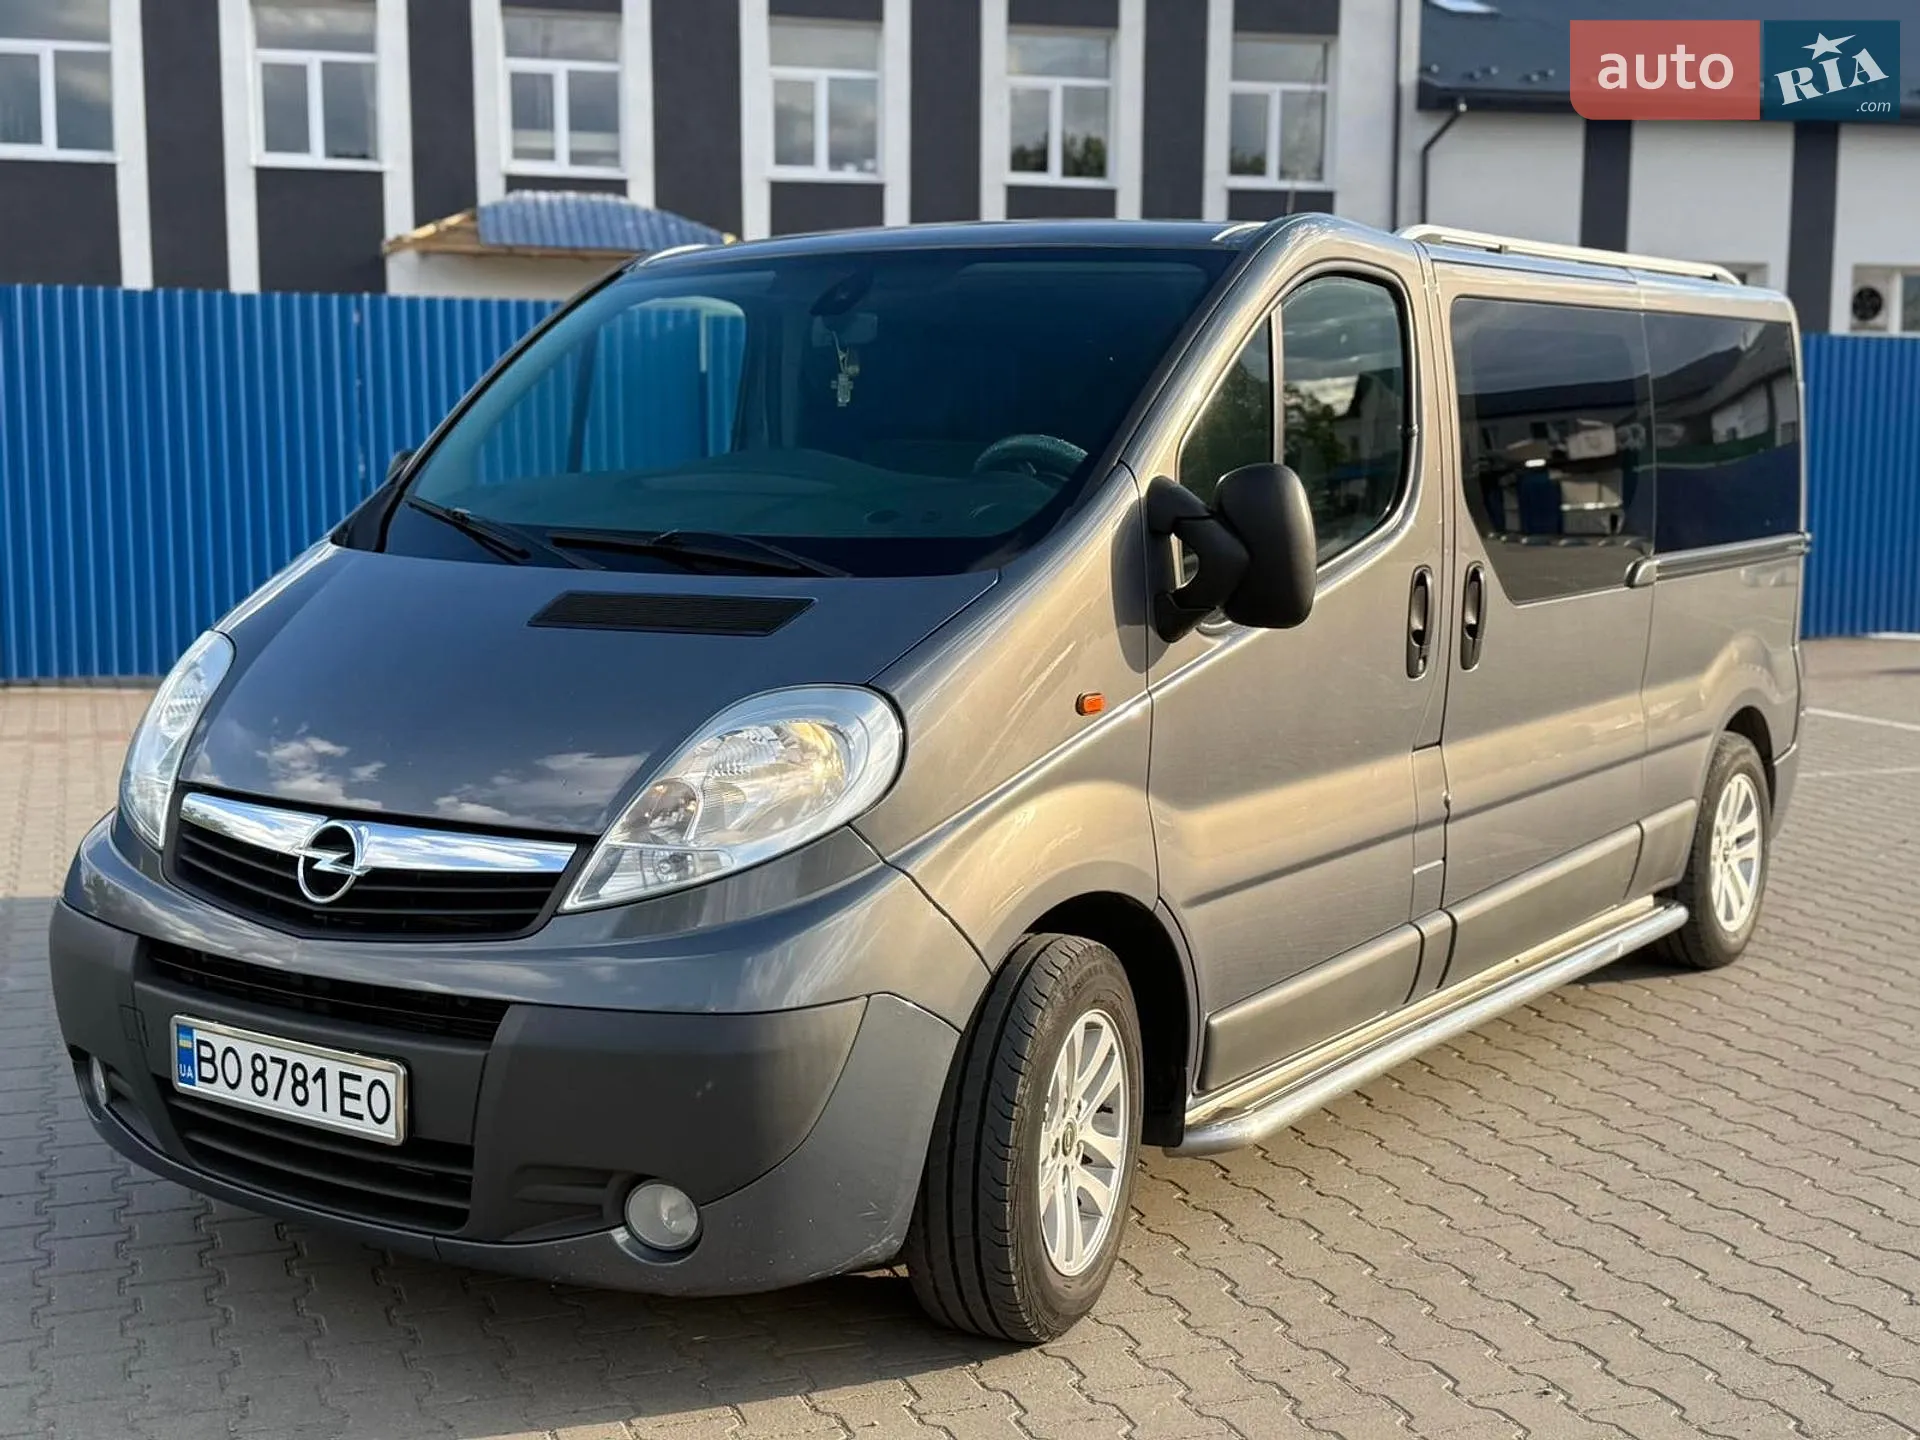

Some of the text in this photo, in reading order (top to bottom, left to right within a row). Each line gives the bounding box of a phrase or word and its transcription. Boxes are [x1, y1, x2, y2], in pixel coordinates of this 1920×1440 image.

[179, 1064, 194, 1079] UA
[196, 1039, 391, 1125] BO 8781 EO
